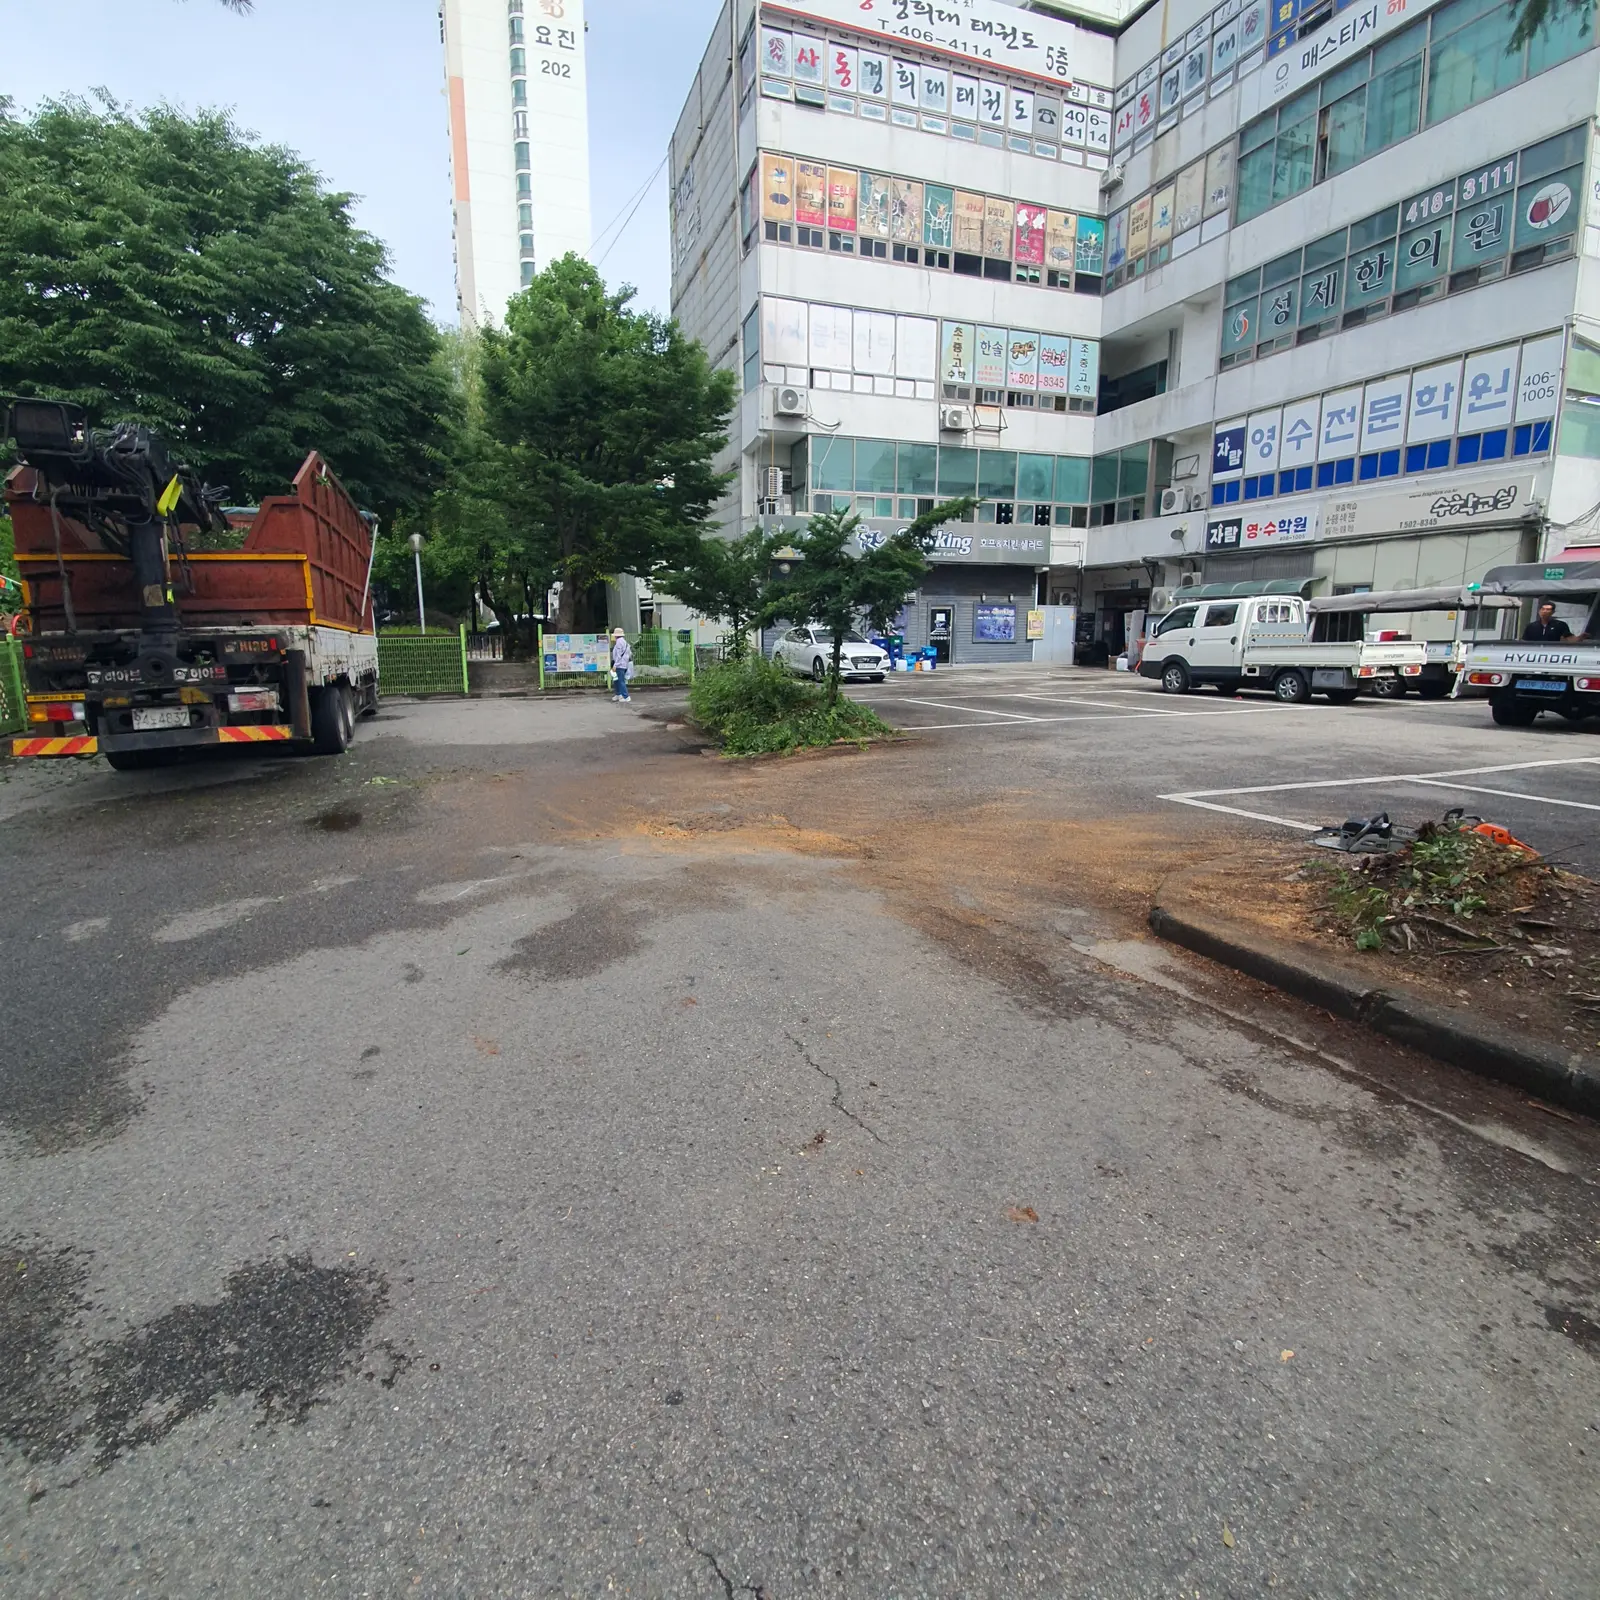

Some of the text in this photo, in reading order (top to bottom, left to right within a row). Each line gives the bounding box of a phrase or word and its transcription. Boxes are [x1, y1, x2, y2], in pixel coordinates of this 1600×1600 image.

[535, 25, 575, 50] 요진
[970, 18, 1039, 50] 태권도
[1302, 5, 1378, 70] 매스티지
[541, 60, 571, 78] 202
[1268, 204, 1506, 327] 성제한의원
[980, 340, 1004, 358] 한솔
[1521, 385, 1556, 404] 1005
[1251, 368, 1511, 458] 영수전문학원
[1217, 435, 1243, 466] 자람
[1430, 485, 1517, 518] 수학교실
[1209, 523, 1239, 544] 자람
[1504, 653, 1578, 664] HYUNDAI
